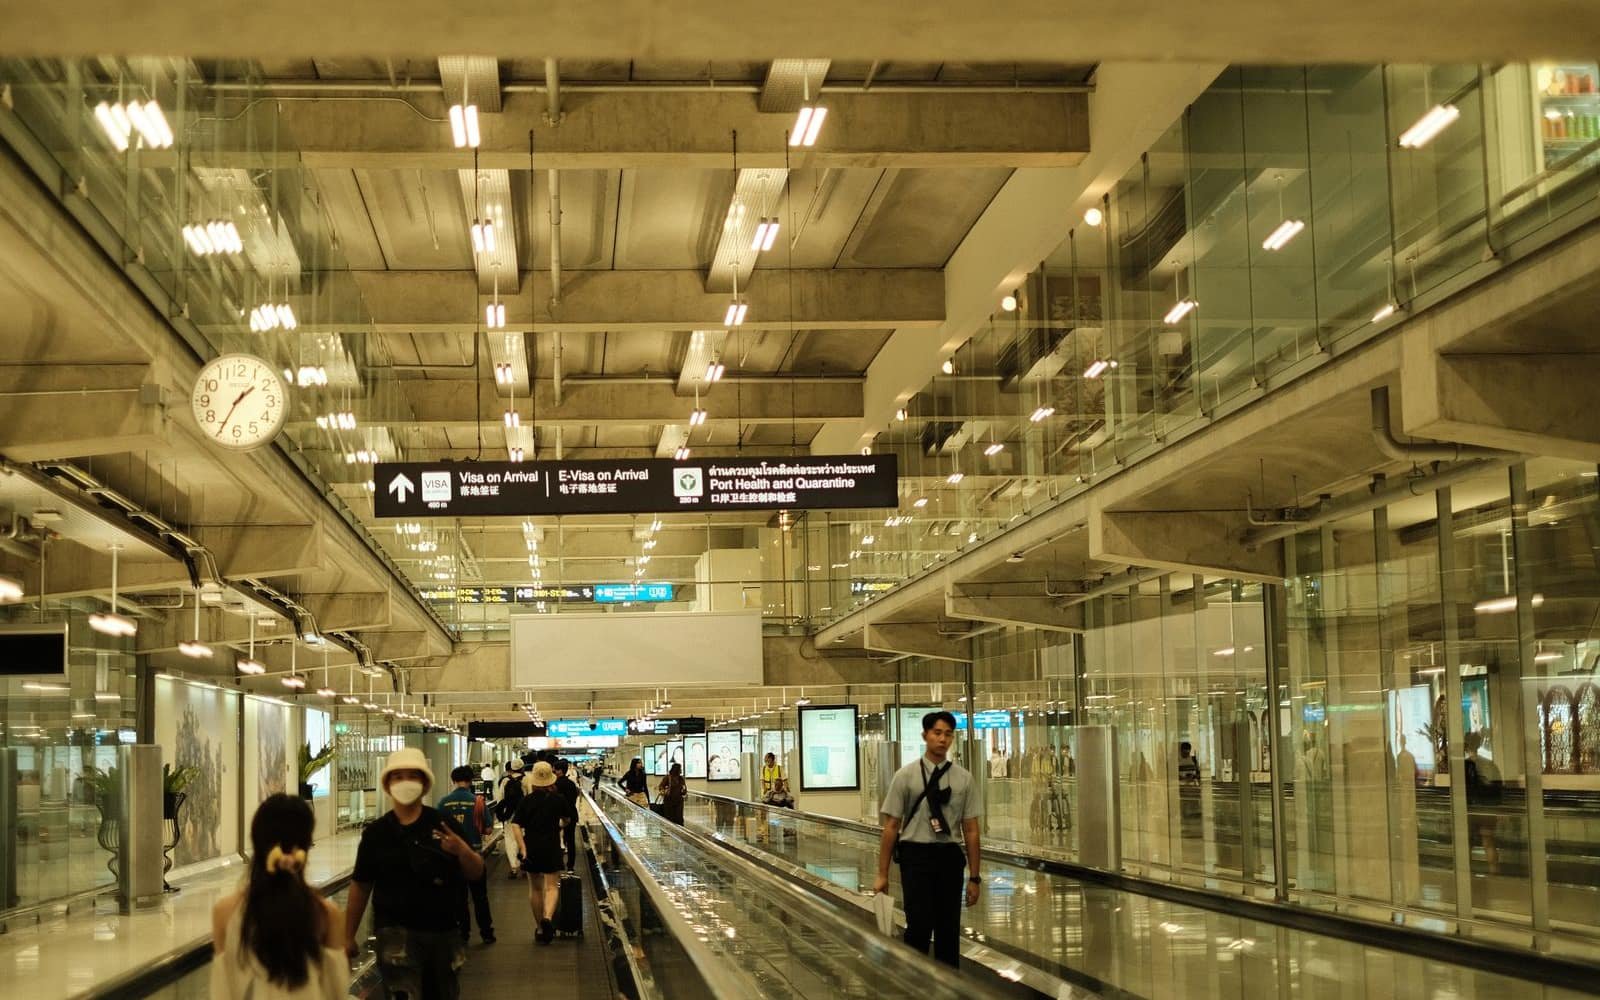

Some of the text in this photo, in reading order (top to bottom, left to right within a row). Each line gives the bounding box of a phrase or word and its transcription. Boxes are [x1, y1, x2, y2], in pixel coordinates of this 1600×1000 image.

[219, 368, 229, 380] 11
[232, 364, 247, 377] 12
[205, 380, 218, 392] 10
[262, 379, 271, 391] 2
[200, 395, 210, 407] 9
[265, 395, 275, 408] 3
[206, 410, 216, 422] 8
[260, 410, 269, 422] 4
[232, 425, 242, 438] 6
[249, 422, 258, 434] 5
[459, 470, 538, 483] Visa on Arrival
[558, 468, 648, 481] E-Visa on Arrival
[424, 480, 448, 488] VISA
[710, 477, 855, 490] Port Health and Quarantine
